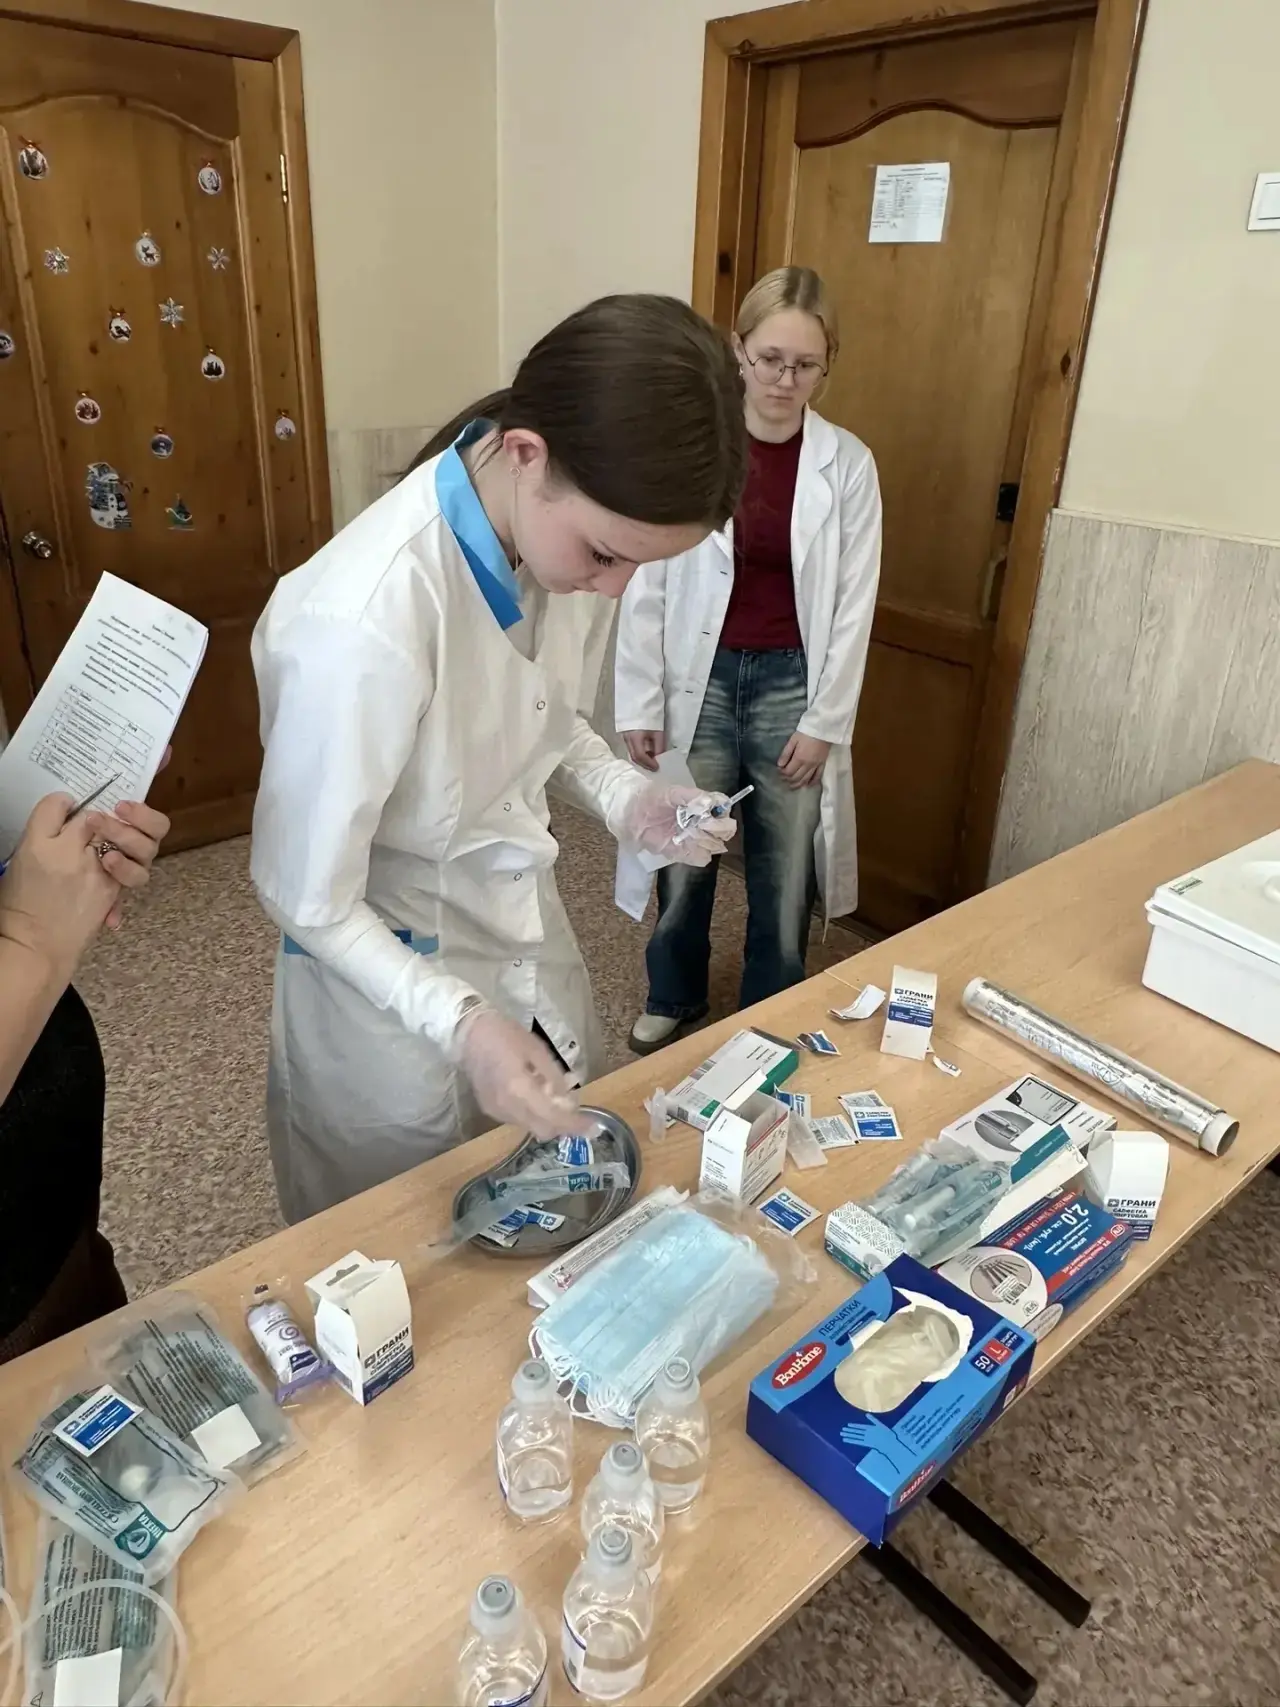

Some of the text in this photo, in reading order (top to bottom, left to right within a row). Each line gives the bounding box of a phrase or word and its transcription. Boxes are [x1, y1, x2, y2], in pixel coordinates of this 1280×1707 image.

[903, 988, 934, 1000] ГРАНИ
[1121, 1199, 1156, 1207] ГРАНИ
[818, 1299, 862, 1337] ПЕРЧАТКИ
[375, 1327, 409, 1357] ГРАНИ
[988, 1343, 1001, 1355] L
[776, 1346, 823, 1386] BonHome
[975, 1357, 990, 1371] 50
